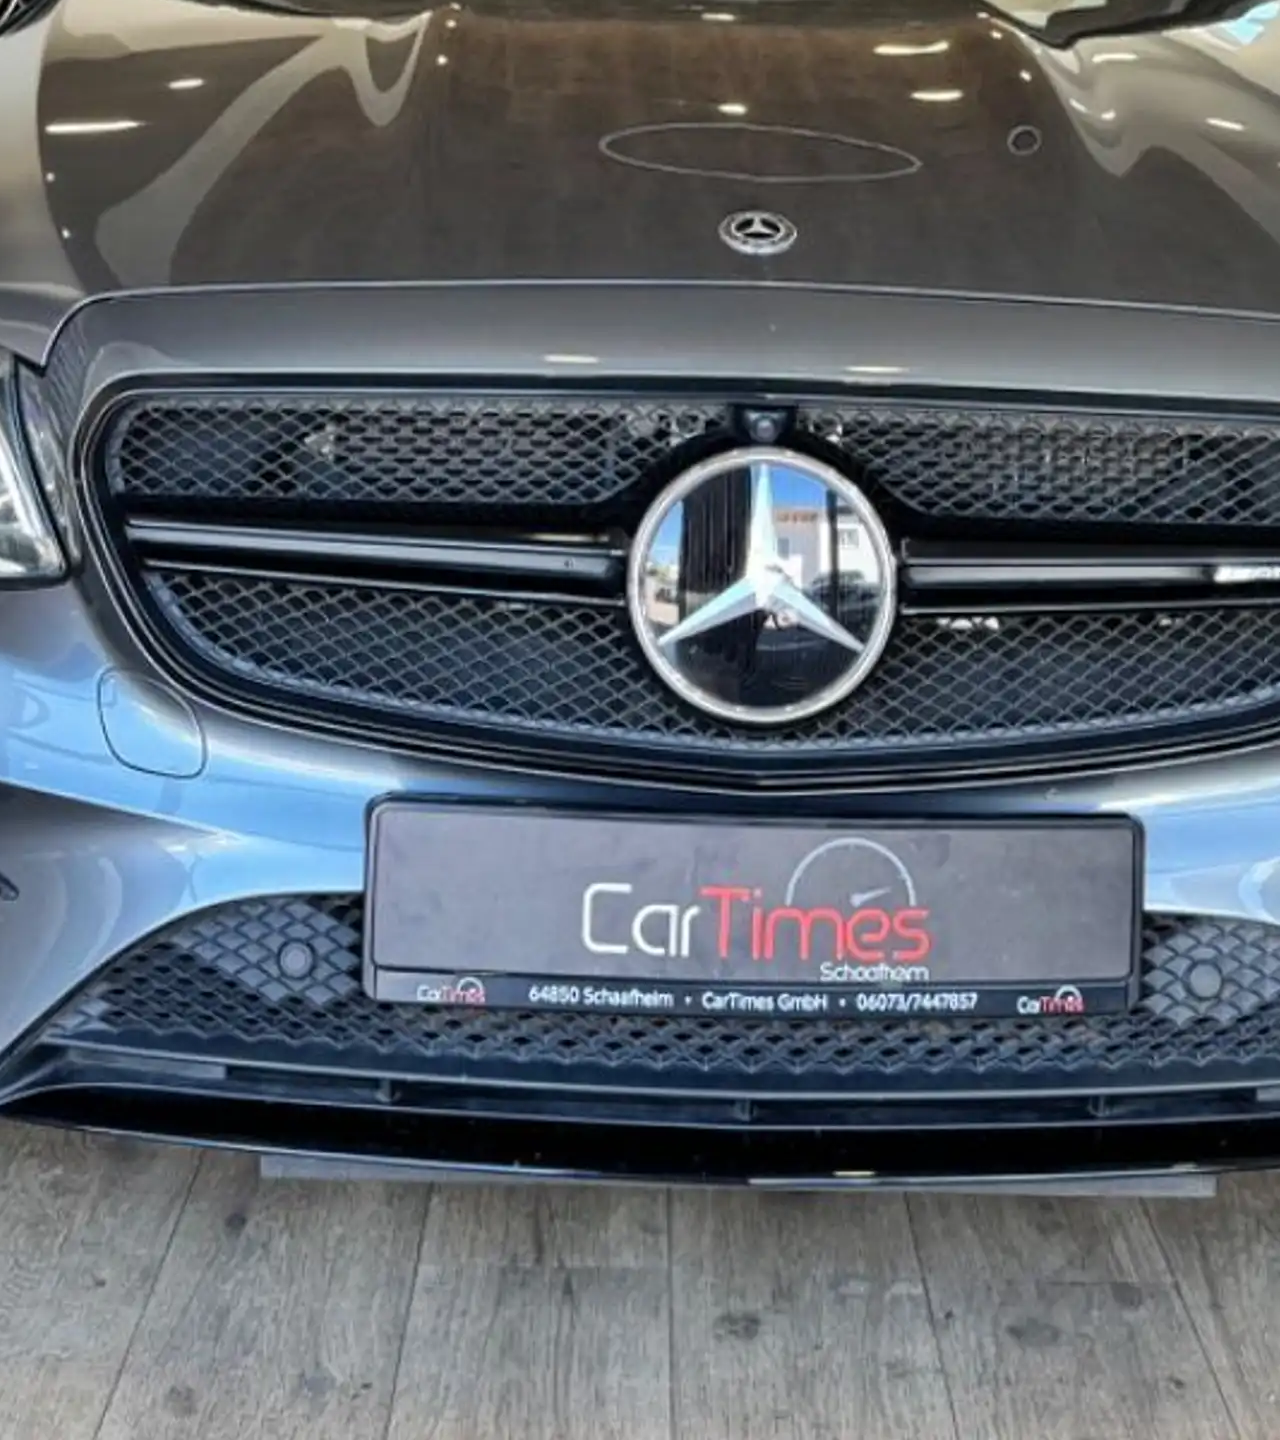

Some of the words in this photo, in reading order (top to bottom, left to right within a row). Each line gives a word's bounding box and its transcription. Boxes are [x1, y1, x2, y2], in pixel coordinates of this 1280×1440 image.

[582, 883, 932, 961] CarTimes
[820, 963, 929, 982] Schaafheim
[529, 986, 579, 1005] 64850
[583, 987, 674, 1008] Schaafheim
[701, 992, 773, 1011] CarTimes
[777, 994, 828, 1011] GmbH
